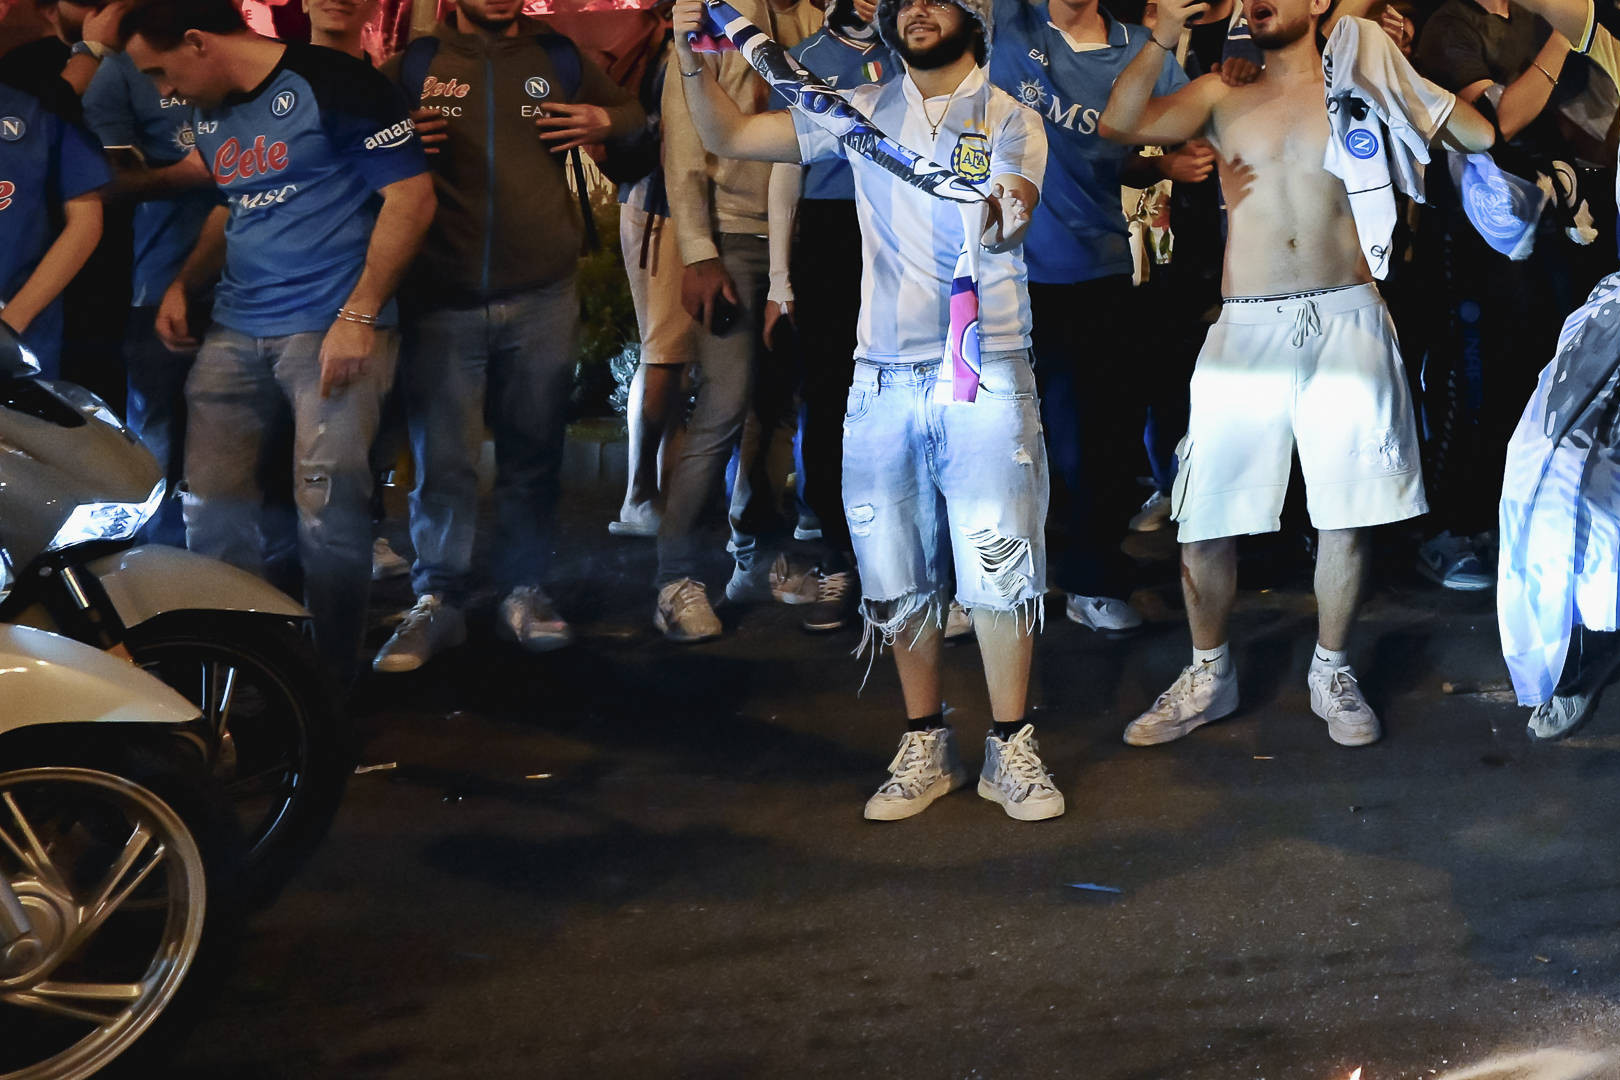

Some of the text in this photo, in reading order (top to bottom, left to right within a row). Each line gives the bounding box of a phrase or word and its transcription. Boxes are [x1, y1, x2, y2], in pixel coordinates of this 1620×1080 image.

[530, 81, 545, 94] N
[276, 95, 290, 112] N
[521, 106, 550, 118] EA
[1045, 94, 1100, 135] MS
[363, 119, 415, 150] amazo
[213, 136, 289, 185] Lete
[961, 146, 986, 170] AFA
